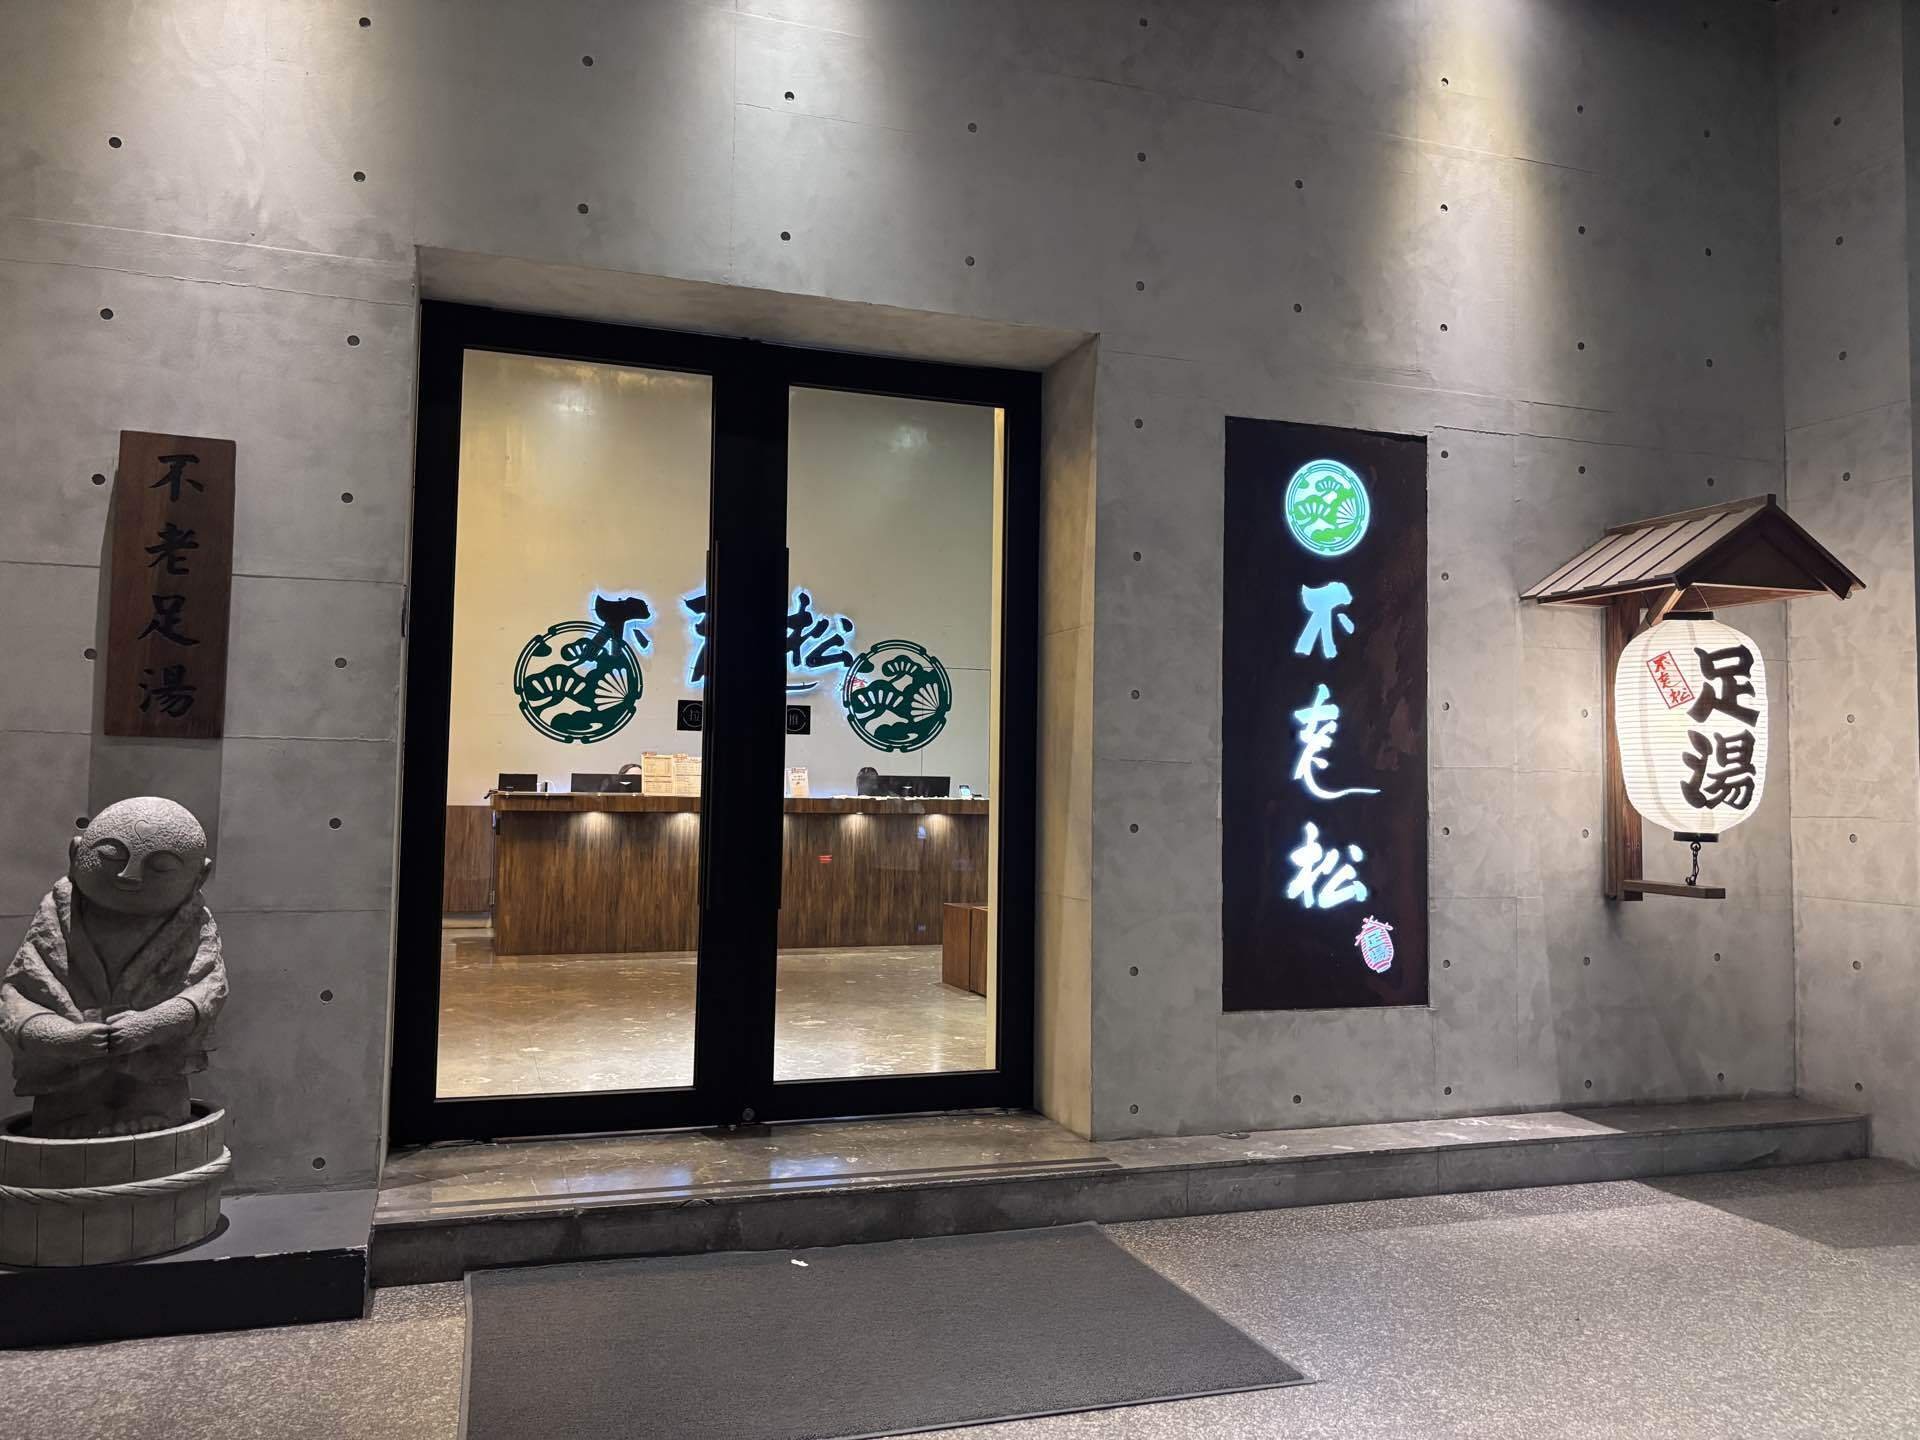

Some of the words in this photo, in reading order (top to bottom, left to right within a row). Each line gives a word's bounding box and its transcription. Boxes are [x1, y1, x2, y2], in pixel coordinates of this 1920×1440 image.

[137, 453, 205, 717] 不老足湯
[1285, 581, 1381, 909] 不老松
[1679, 643, 1761, 811] 足湯
